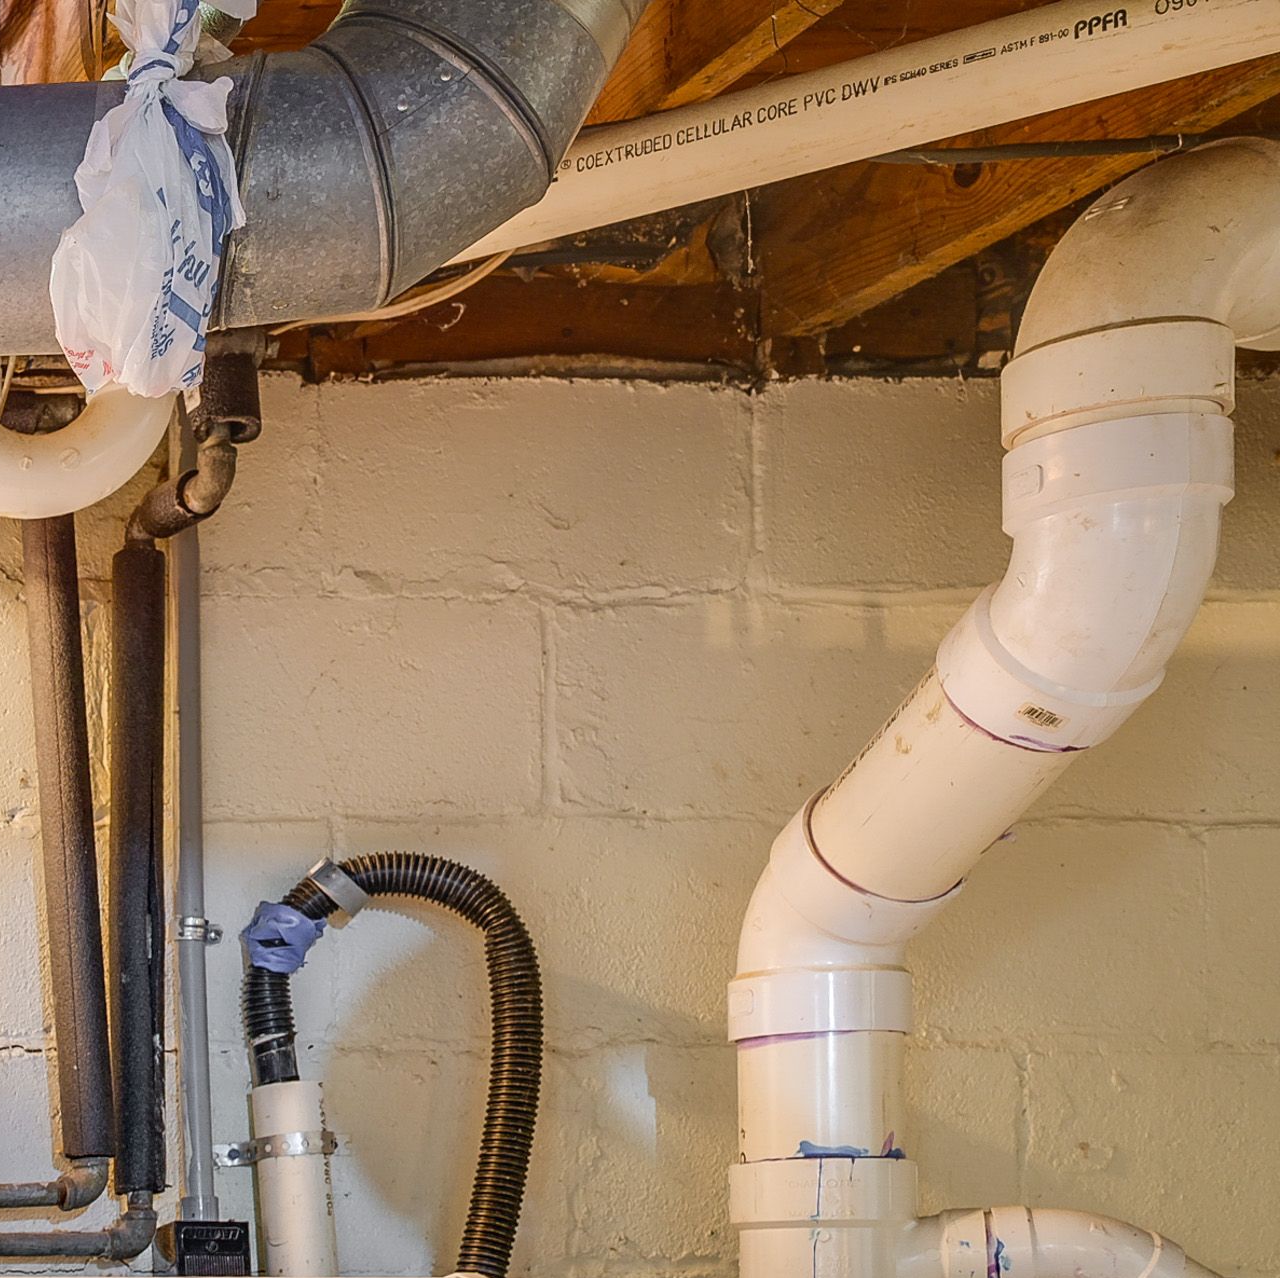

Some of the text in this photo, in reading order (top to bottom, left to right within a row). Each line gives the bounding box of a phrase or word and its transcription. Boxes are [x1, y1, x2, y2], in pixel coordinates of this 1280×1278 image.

[576, 133, 672, 173] COEXTRUDED
[676, 111, 753, 145] CELLULAR
[757, 99, 798, 124] CORE
[803, 88, 837, 112] PVC
[841, 76, 881, 102] DWV
[929, 58, 959, 74] SERIES
[1000, 38, 1028, 55] ASTM
[1029, 36, 1037, 47] F
